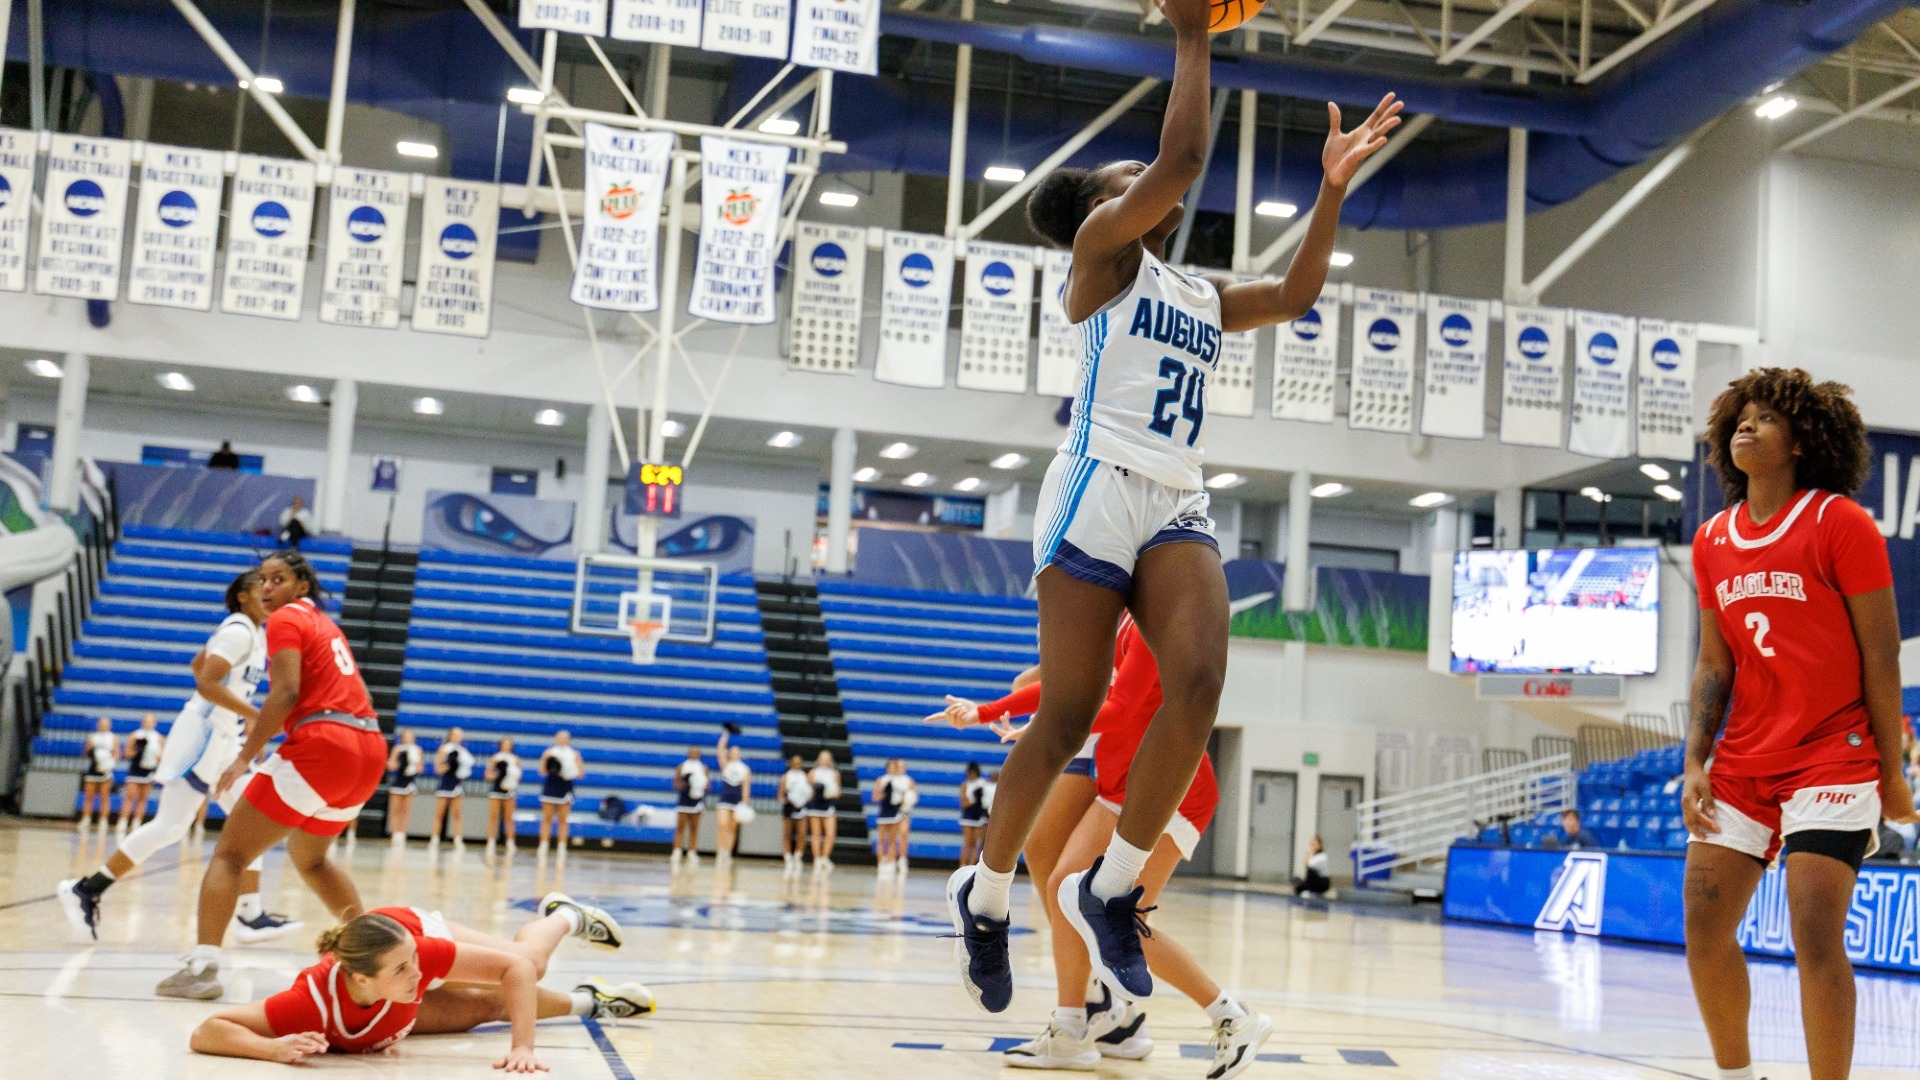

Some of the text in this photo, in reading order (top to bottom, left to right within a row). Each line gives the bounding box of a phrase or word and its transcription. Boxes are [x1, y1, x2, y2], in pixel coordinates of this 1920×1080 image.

[629, 14, 685, 34] 2008-09
[812, 7, 863, 26] NATIONAL
[719, 26, 772, 44] 2009-10
[813, 26, 858, 44] FINALIST
[74, 142, 108, 158] MEN'S
[611, 136, 646, 152] MEN'S
[167, 154, 202, 168] MEN'S
[590, 152, 660, 174] BASKETBALL
[728, 148, 761, 164] MEN'S
[50, 156, 124, 178] BASKETBALL
[260, 164, 294, 179] MEN'S
[708, 162, 779, 183] BASKETBALL
[146, 168, 217, 189] BASKETBALL
[355, 173, 388, 187] MEN'S
[239, 180, 308, 200] BASKETBALL
[335, 186, 404, 206] BASKETBALL
[446, 188, 479, 202] MEN'S
[446, 203, 474, 218] GOLF
[50, 222, 117, 238] SOUTHEAST
[52, 240, 108, 256] REGIONAL
[348, 248, 381, 260] SOUTH
[145, 250, 200, 268] REGIONAL
[238, 258, 292, 276] REGIONAL
[339, 262, 388, 278] ATLANTIC
[430, 265, 480, 282] CENTRAL
[584, 262, 648, 284] CONFERENCE
[702, 261, 768, 282] CONFERENCE
[336, 278, 386, 294] REGIONAL
[428, 281, 479, 298] REGIONAL
[582, 284, 646, 304] CHAMPIONS
[421, 296, 484, 314] CHAMPIONS
[701, 296, 764, 315] CHAMPIONS
[1148, 356, 1206, 448] 24
[1744, 611, 1776, 658] 2
[1523, 678, 1574, 698] Coke
[1534, 852, 1608, 936] A
